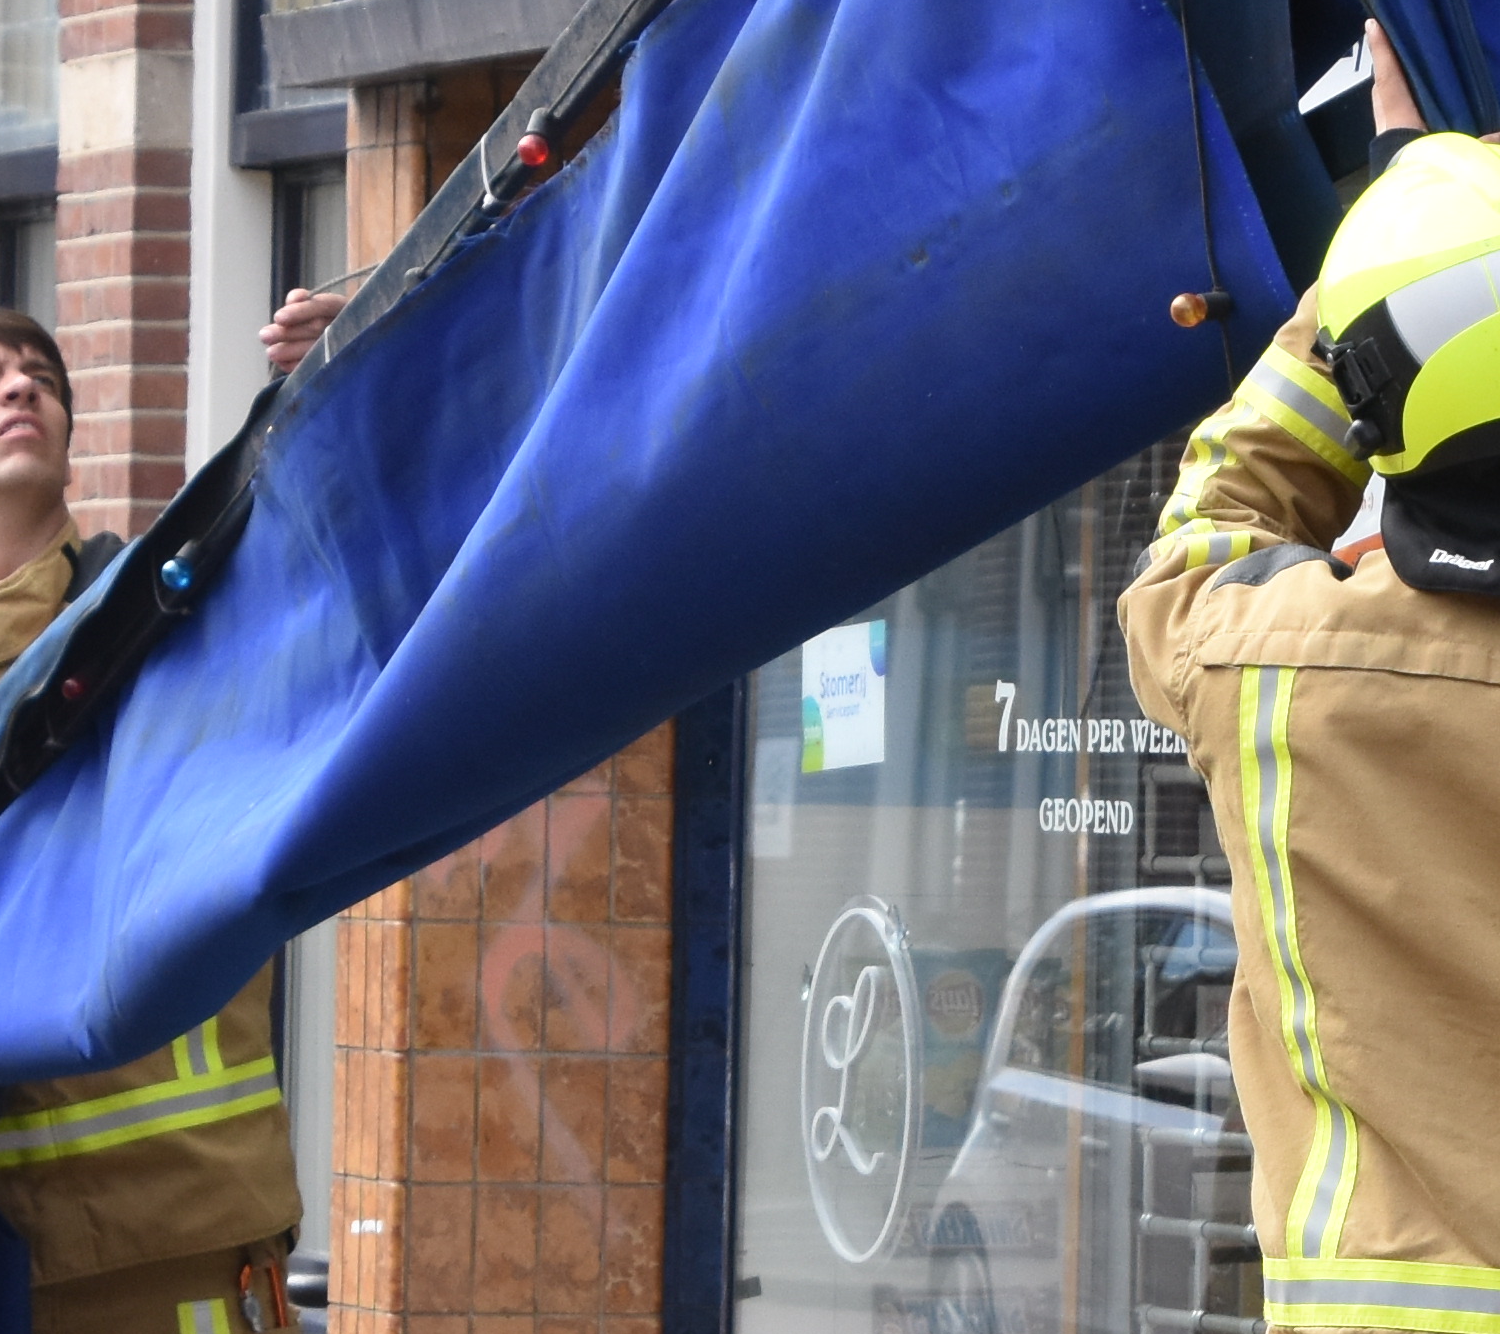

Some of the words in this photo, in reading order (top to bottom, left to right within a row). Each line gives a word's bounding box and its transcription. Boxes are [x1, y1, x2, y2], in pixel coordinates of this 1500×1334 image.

[1429, 548, 1495, 571] Dräger
[820, 666, 867, 699] Stomerij
[995, 679, 1016, 752] 7
[1016, 718, 1082, 752] DAGEN
[1086, 718, 1125, 753] PER
[1039, 798, 1134, 835] GEOPEND
